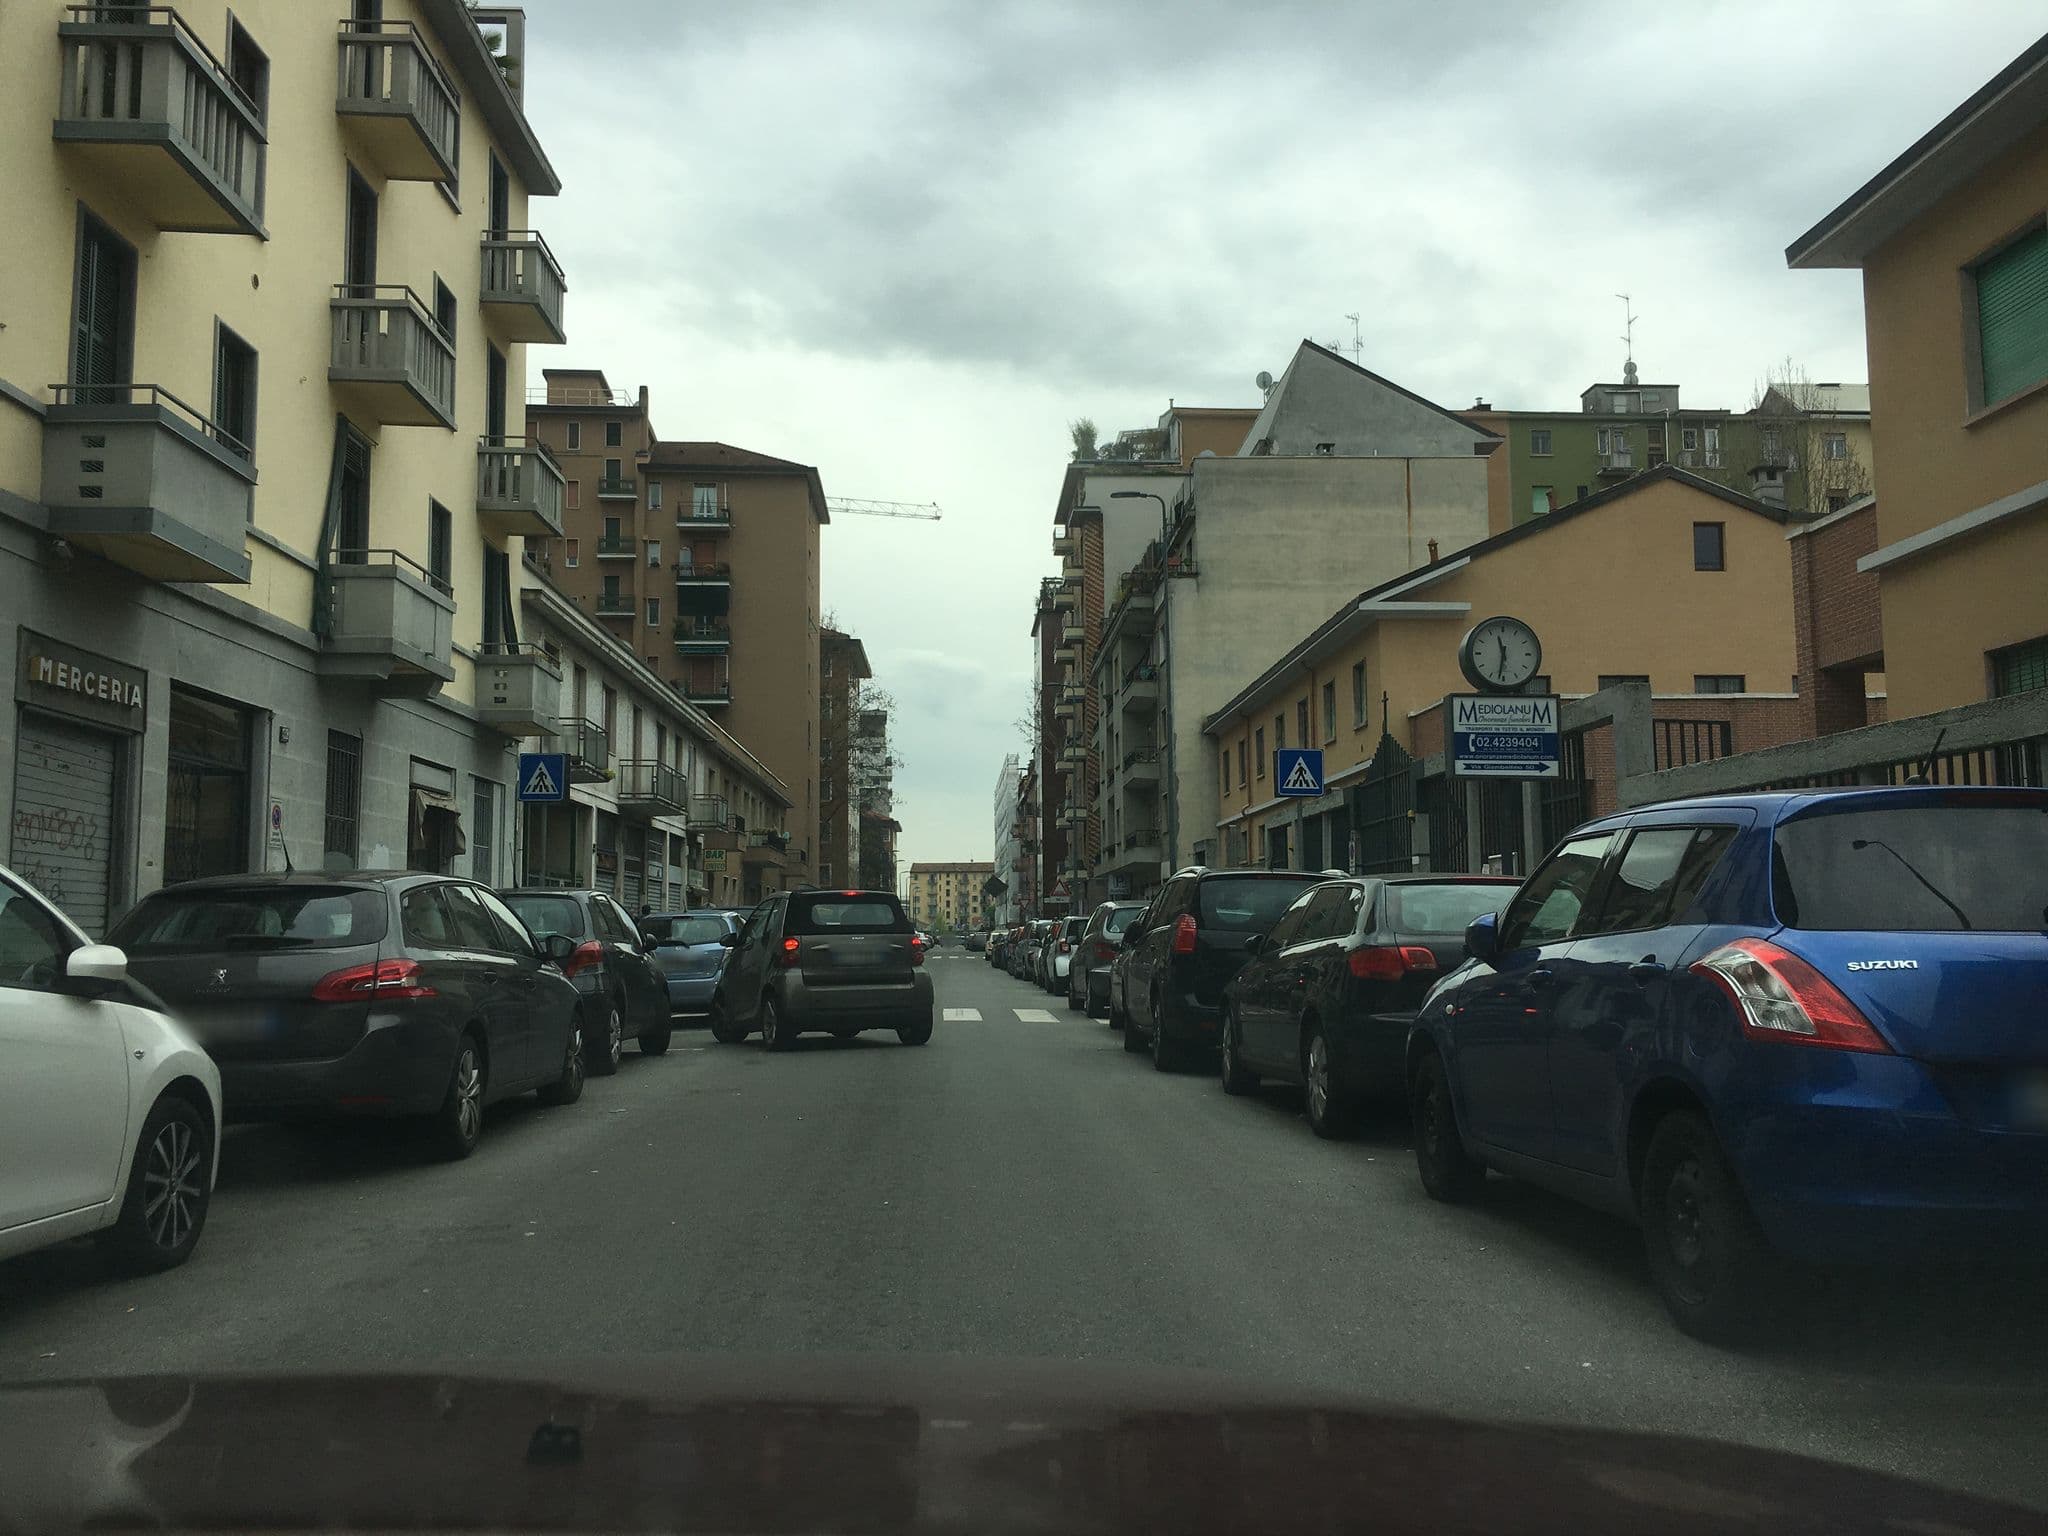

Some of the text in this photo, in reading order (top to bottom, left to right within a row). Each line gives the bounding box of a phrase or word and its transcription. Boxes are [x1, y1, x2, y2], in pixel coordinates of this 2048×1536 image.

[39, 656, 143, 708] MERCERIA
[1459, 700, 1551, 723] MEDIOLANUM
[1476, 737, 1539, 748] 02.4239404
[705, 850, 724, 860] BAR
[1847, 960, 1918, 971] SUZUKI
